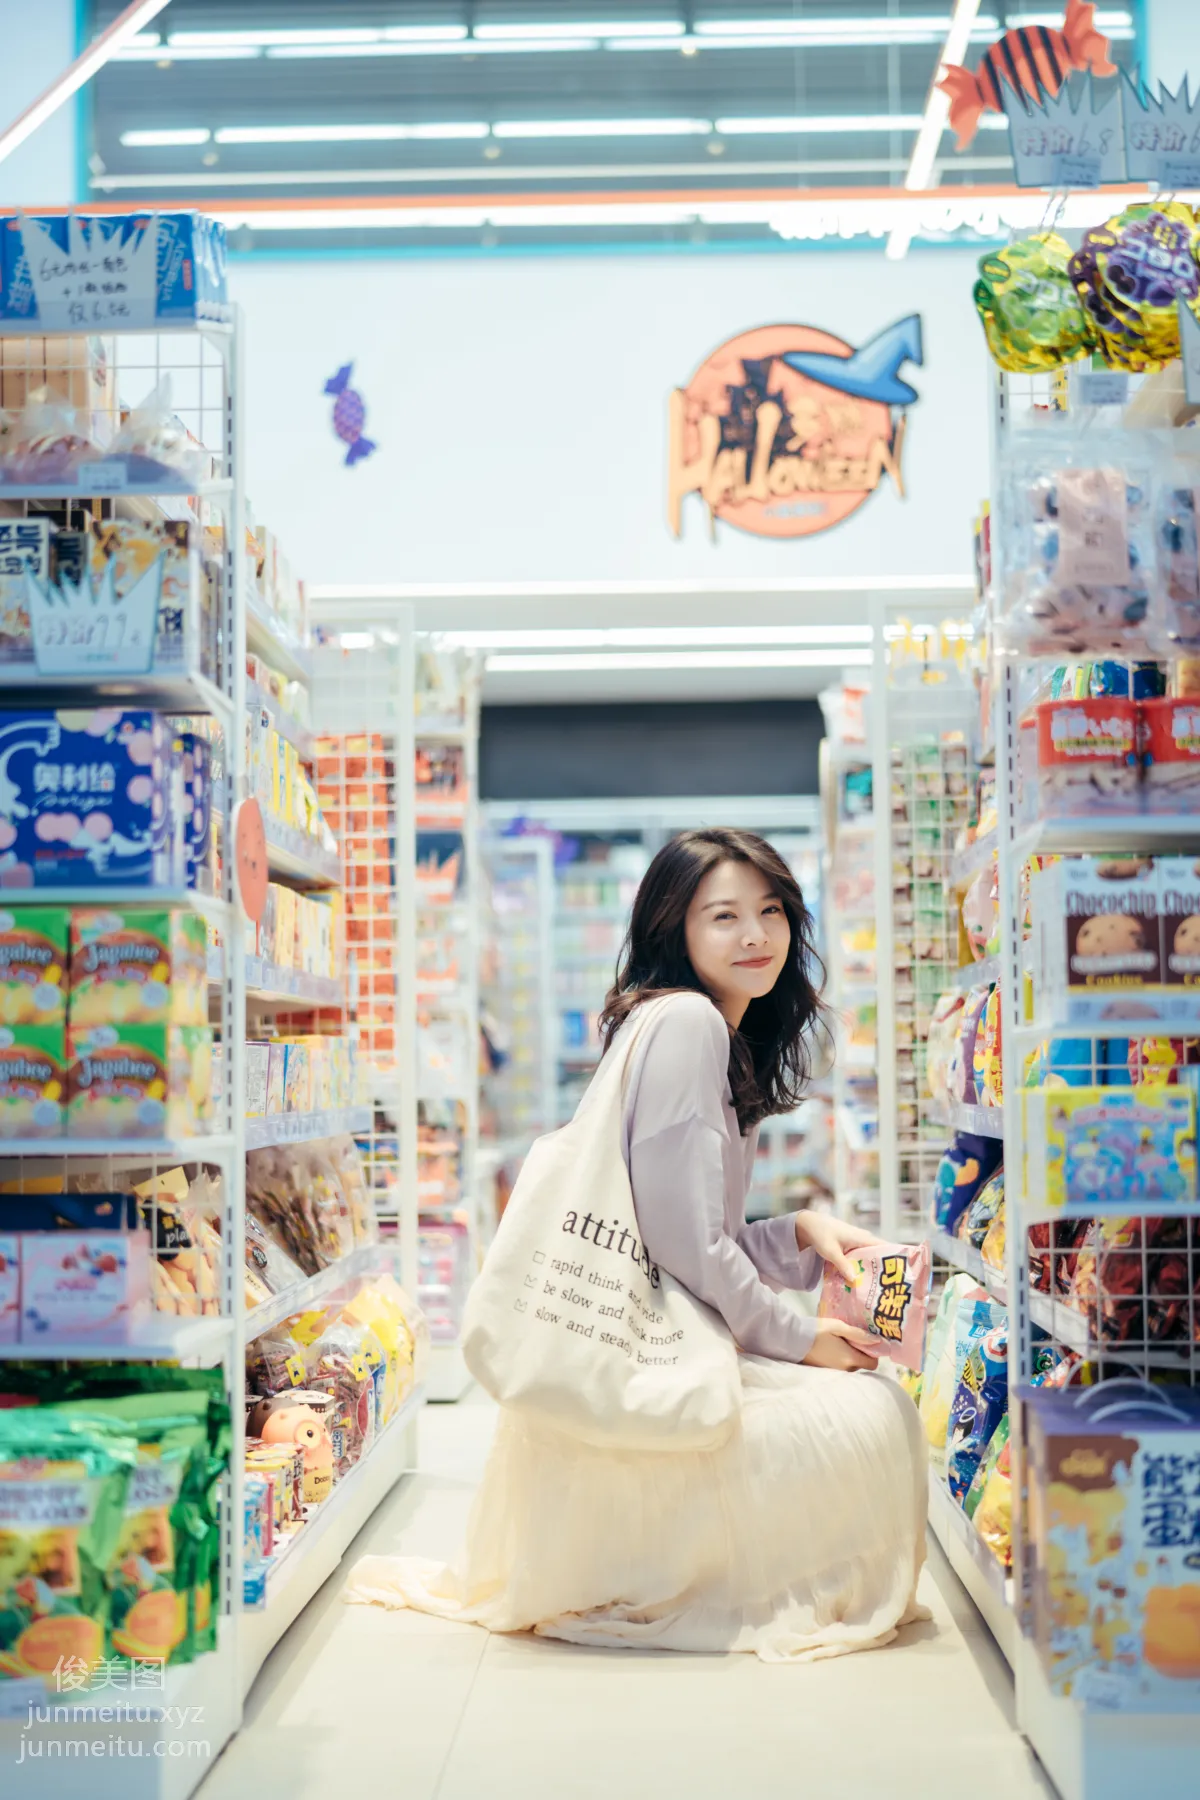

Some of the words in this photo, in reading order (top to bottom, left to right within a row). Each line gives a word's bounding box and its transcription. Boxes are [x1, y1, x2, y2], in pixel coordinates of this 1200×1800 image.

[550, 1258, 584, 1278] rapid
[588, 1271, 625, 1293] think
[562, 1210, 660, 1289] attitude
[534, 1306, 561, 1324] slow
[566, 1319, 595, 1338] and
[637, 1351, 679, 1366] better
[543, 1280, 557, 1295] be
[560, 1289, 594, 1309] slow
[598, 1304, 625, 1320] and
[650, 1329, 684, 1346] more
